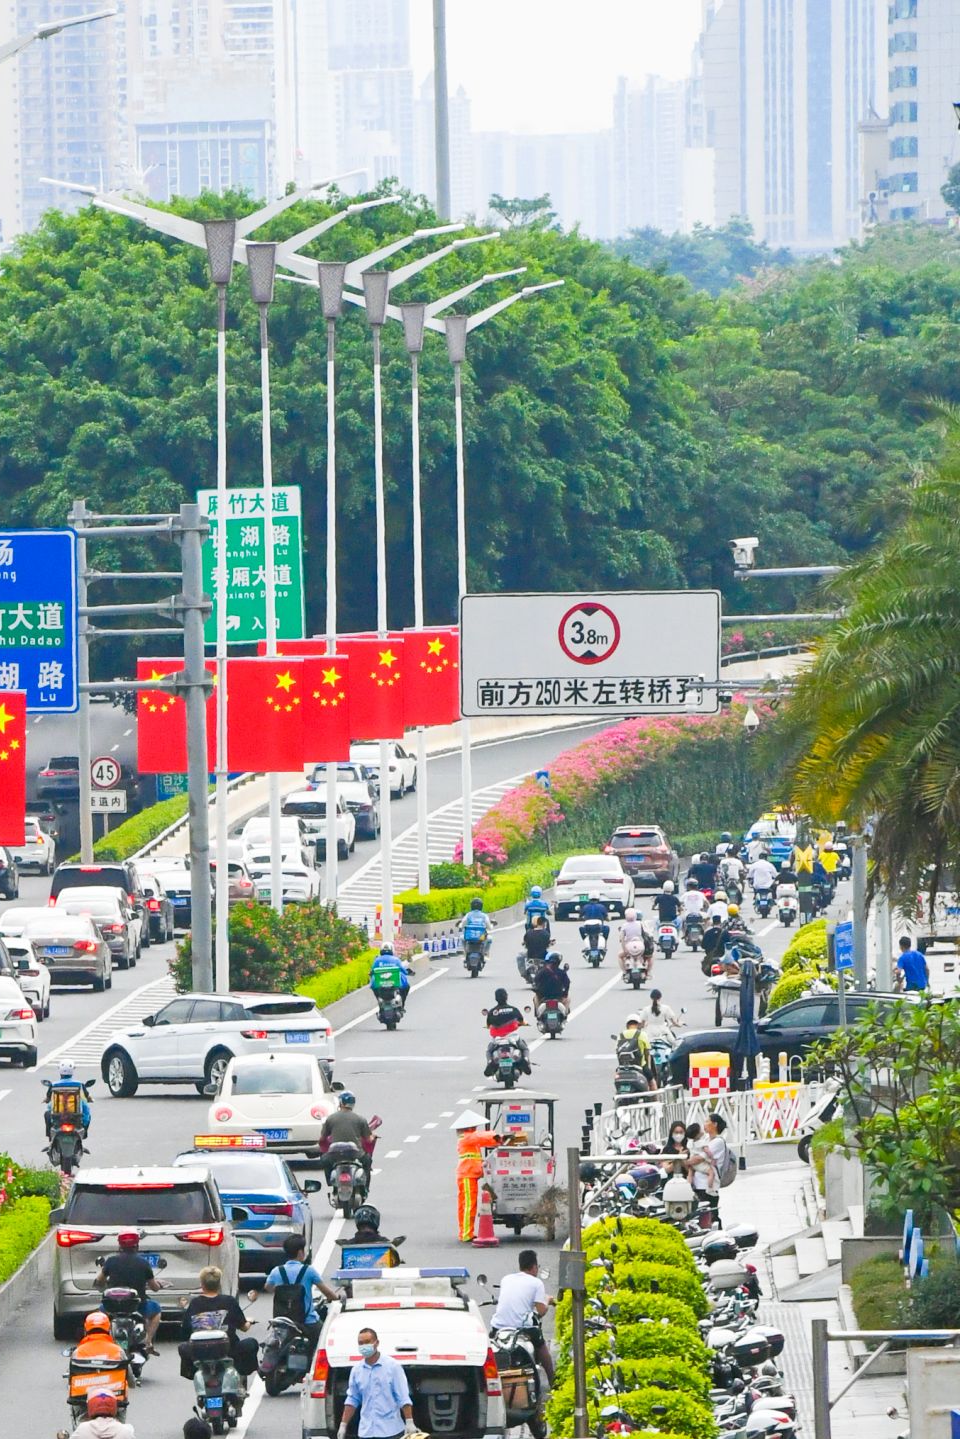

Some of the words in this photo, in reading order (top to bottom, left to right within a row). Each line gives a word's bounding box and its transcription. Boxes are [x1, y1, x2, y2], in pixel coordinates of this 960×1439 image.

[213, 549, 258, 559] Canghu
[276, 548, 288, 556] Lu
[570, 620, 608, 645] 3.8m
[20, 634, 62, 646] Dadao
[40, 691, 57, 703] Lu
[95, 764, 115, 782] 45
